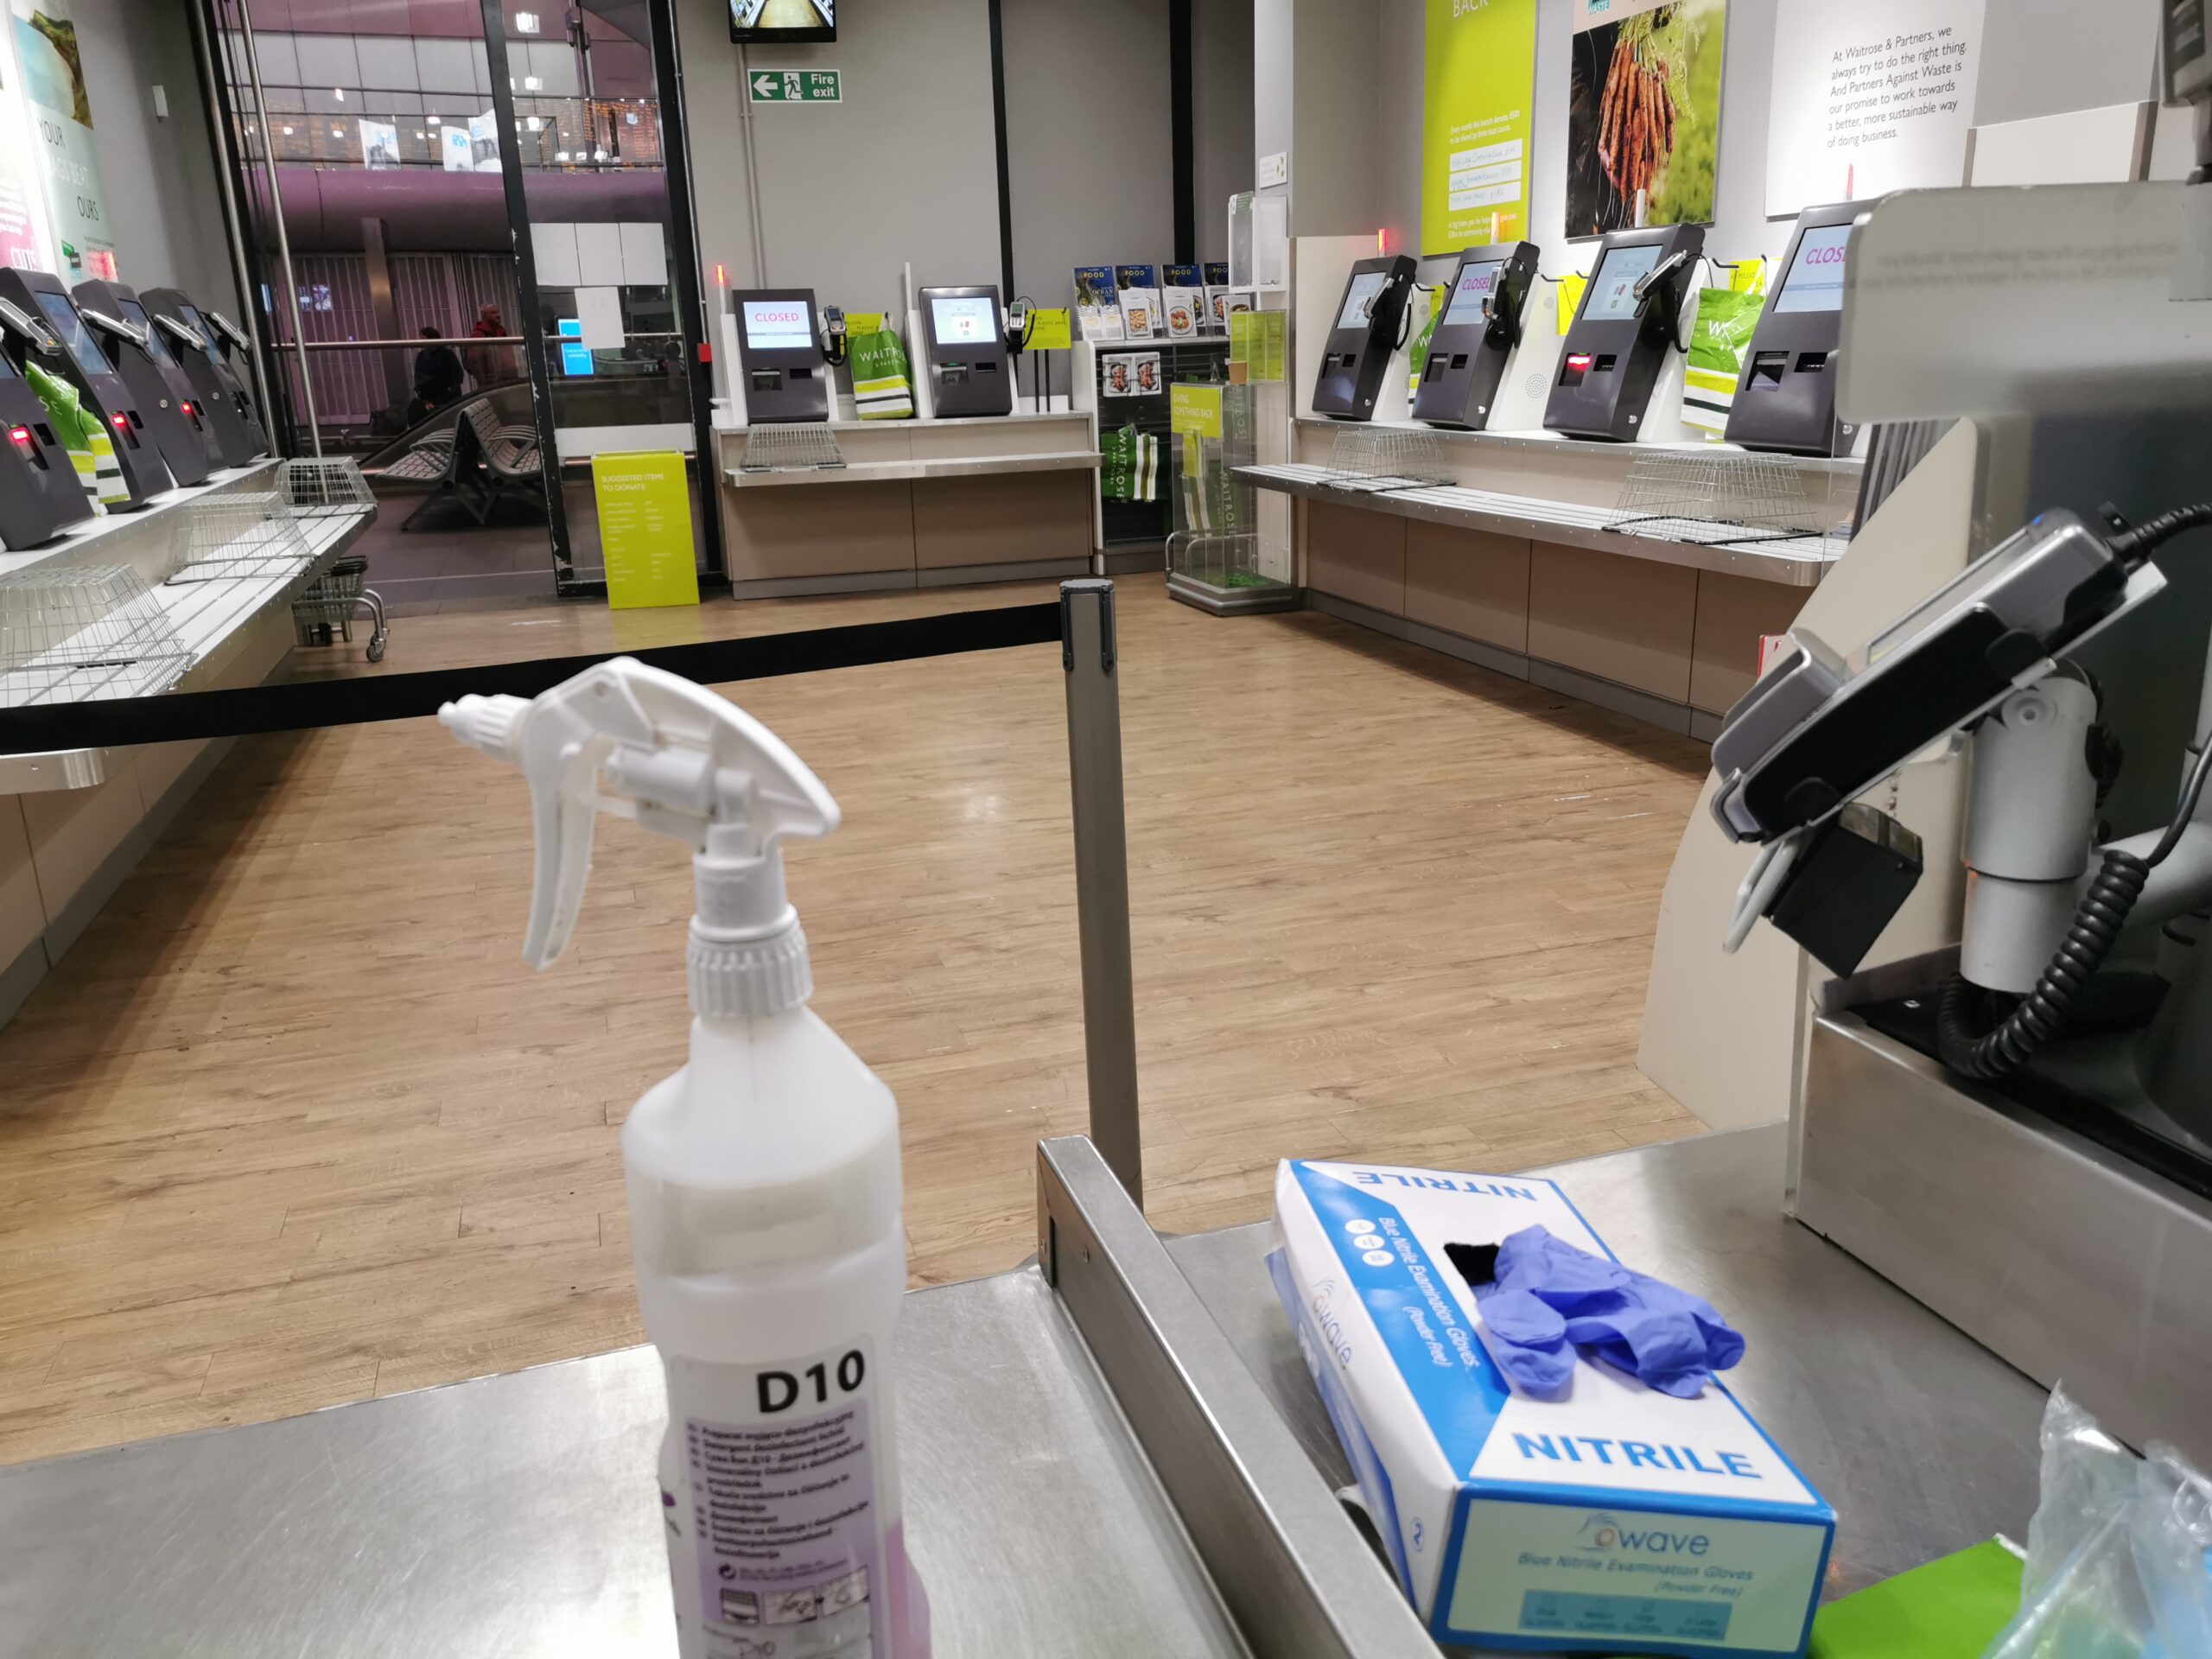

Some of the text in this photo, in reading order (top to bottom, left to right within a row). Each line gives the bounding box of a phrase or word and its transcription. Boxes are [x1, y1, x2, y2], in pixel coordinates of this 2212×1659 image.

[1832, 27, 1952, 63] At Waitrose & Partners, we
[1831, 41, 1967, 81] always try to do the right thing.
[810, 73, 835, 85] Fire
[812, 86, 835, 98] exit
[1829, 60, 1962, 98] And Partners Against Waste is
[1829, 79, 1955, 116] our promise to work towards
[1827, 99, 1958, 131] a better, more sustainable way
[37, 118, 66, 148] YOUR
[1827, 128, 1898, 148] of doing business.
[77, 196, 99, 221] OURS
[754, 312, 799, 322] CLOSED
[1116, 434, 1128, 498] WAITROSE
[1351, 1171, 1537, 1202] NITRILE
[1378, 1217, 1481, 1369] Blue Nitrile Examination Gloves
[756, 1349, 866, 1414] D10
[1512, 1432, 1763, 1478] NITRILE
[1518, 1552, 1754, 1580] Blue Nitrile Examination Gloves
[1655, 1580, 1743, 1598] (Powder Free)
